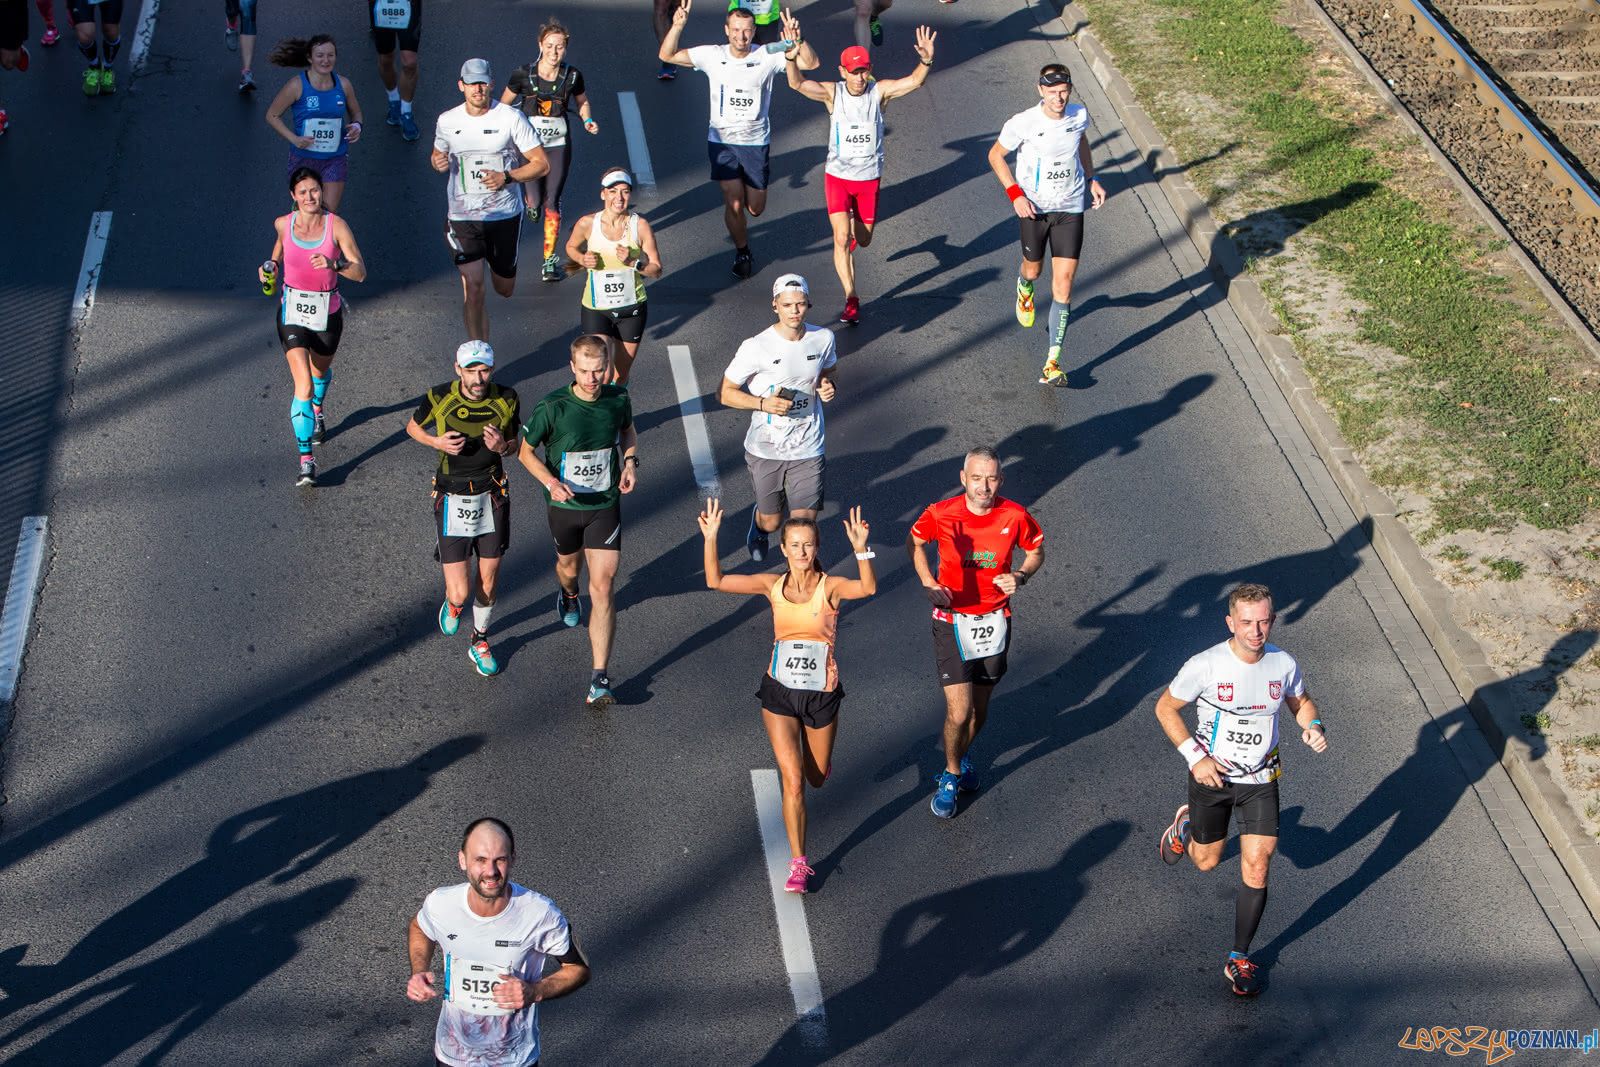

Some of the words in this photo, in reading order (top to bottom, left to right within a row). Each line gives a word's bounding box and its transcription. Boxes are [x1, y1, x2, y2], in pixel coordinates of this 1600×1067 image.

[382, 8, 405, 16] 8888
[729, 97, 754, 107] 5539
[312, 130, 334, 139] 1838
[536, 128, 560, 136] 3924
[846, 134, 871, 144] 4655
[1047, 168, 1071, 180] 2663
[604, 283, 625, 293] 839
[296, 304, 317, 315] 828
[1055, 310, 1069, 344] Kalenji
[791, 398, 808, 410] 255
[573, 464, 602, 476] 2655
[457, 508, 484, 521] 3922
[965, 550, 996, 560] Lucky
[970, 626, 994, 640] 729
[785, 657, 817, 671] 4736
[1226, 731, 1262, 745] 3320
